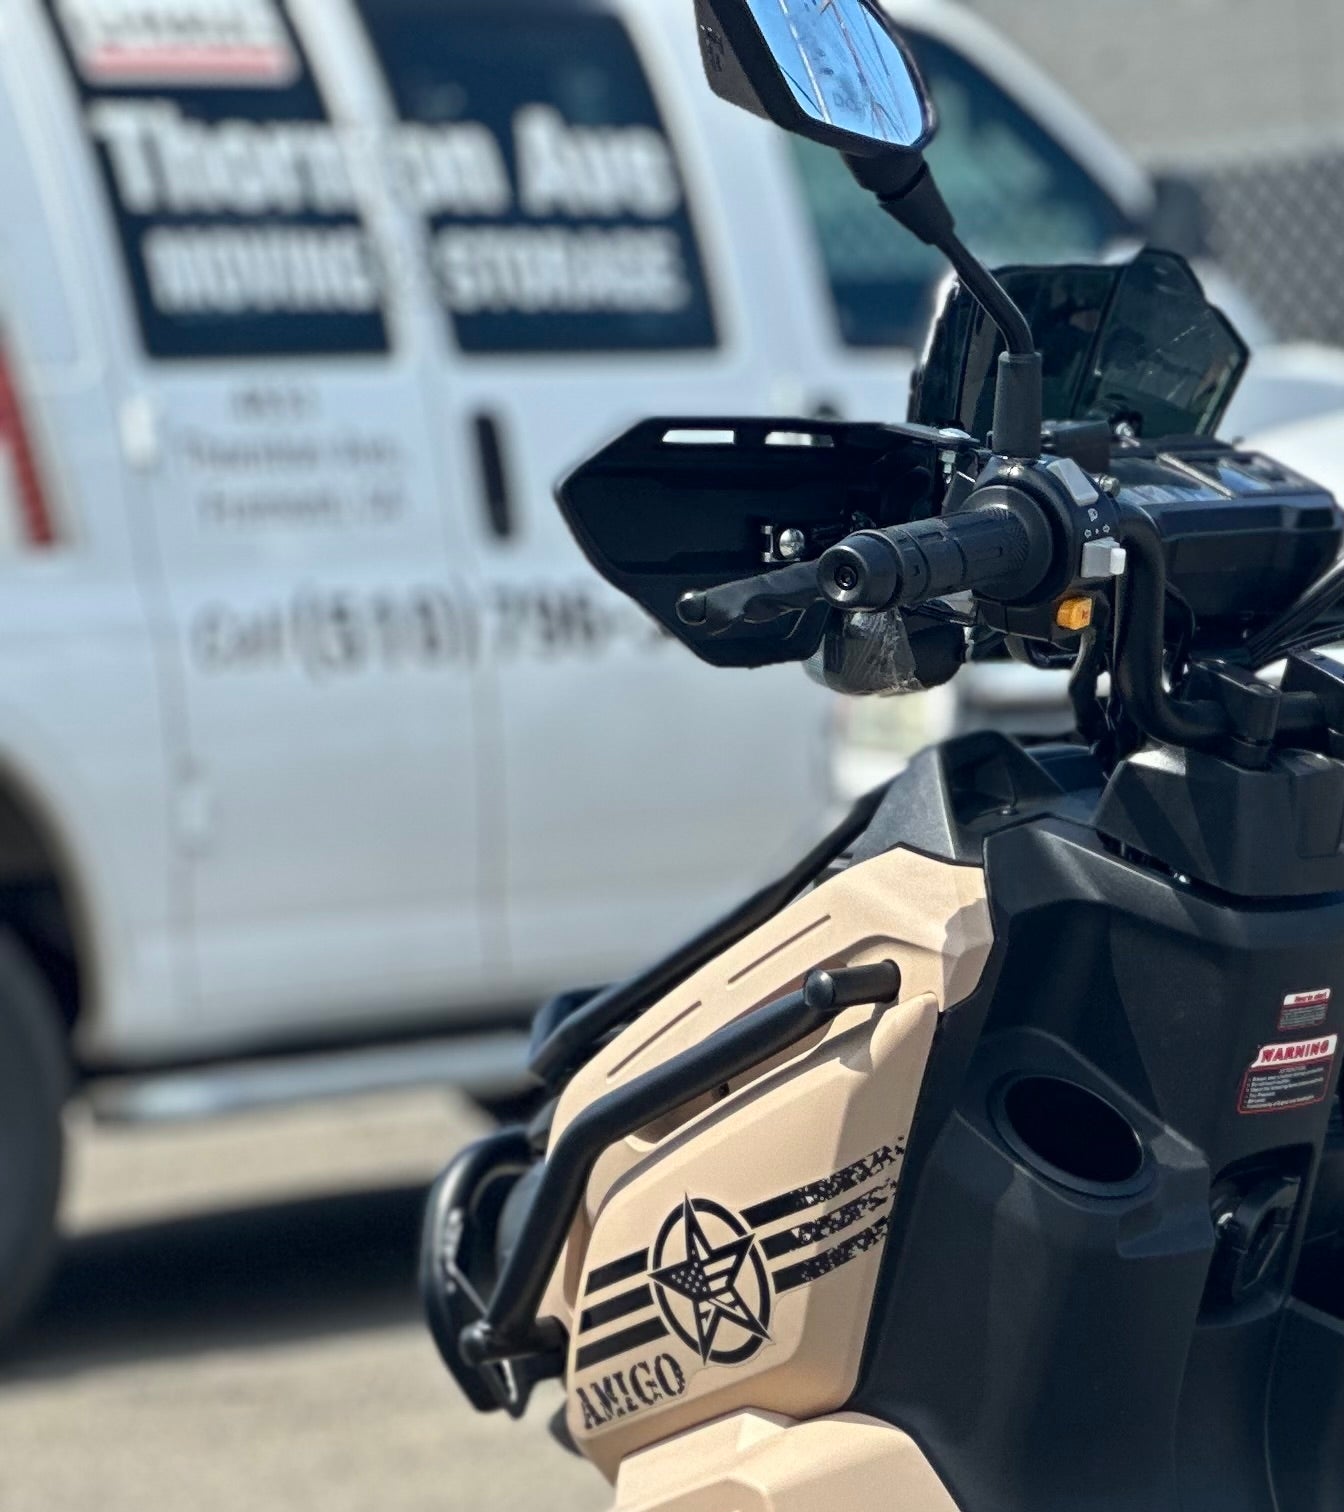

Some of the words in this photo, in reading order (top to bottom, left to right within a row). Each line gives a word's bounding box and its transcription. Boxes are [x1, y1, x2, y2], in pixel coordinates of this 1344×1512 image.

[514, 104, 685, 217] Ave
[430, 226, 690, 313] STORAGE
[1261, 1040, 1329, 1063] WARNING
[575, 1352, 686, 1430] AMIGO
